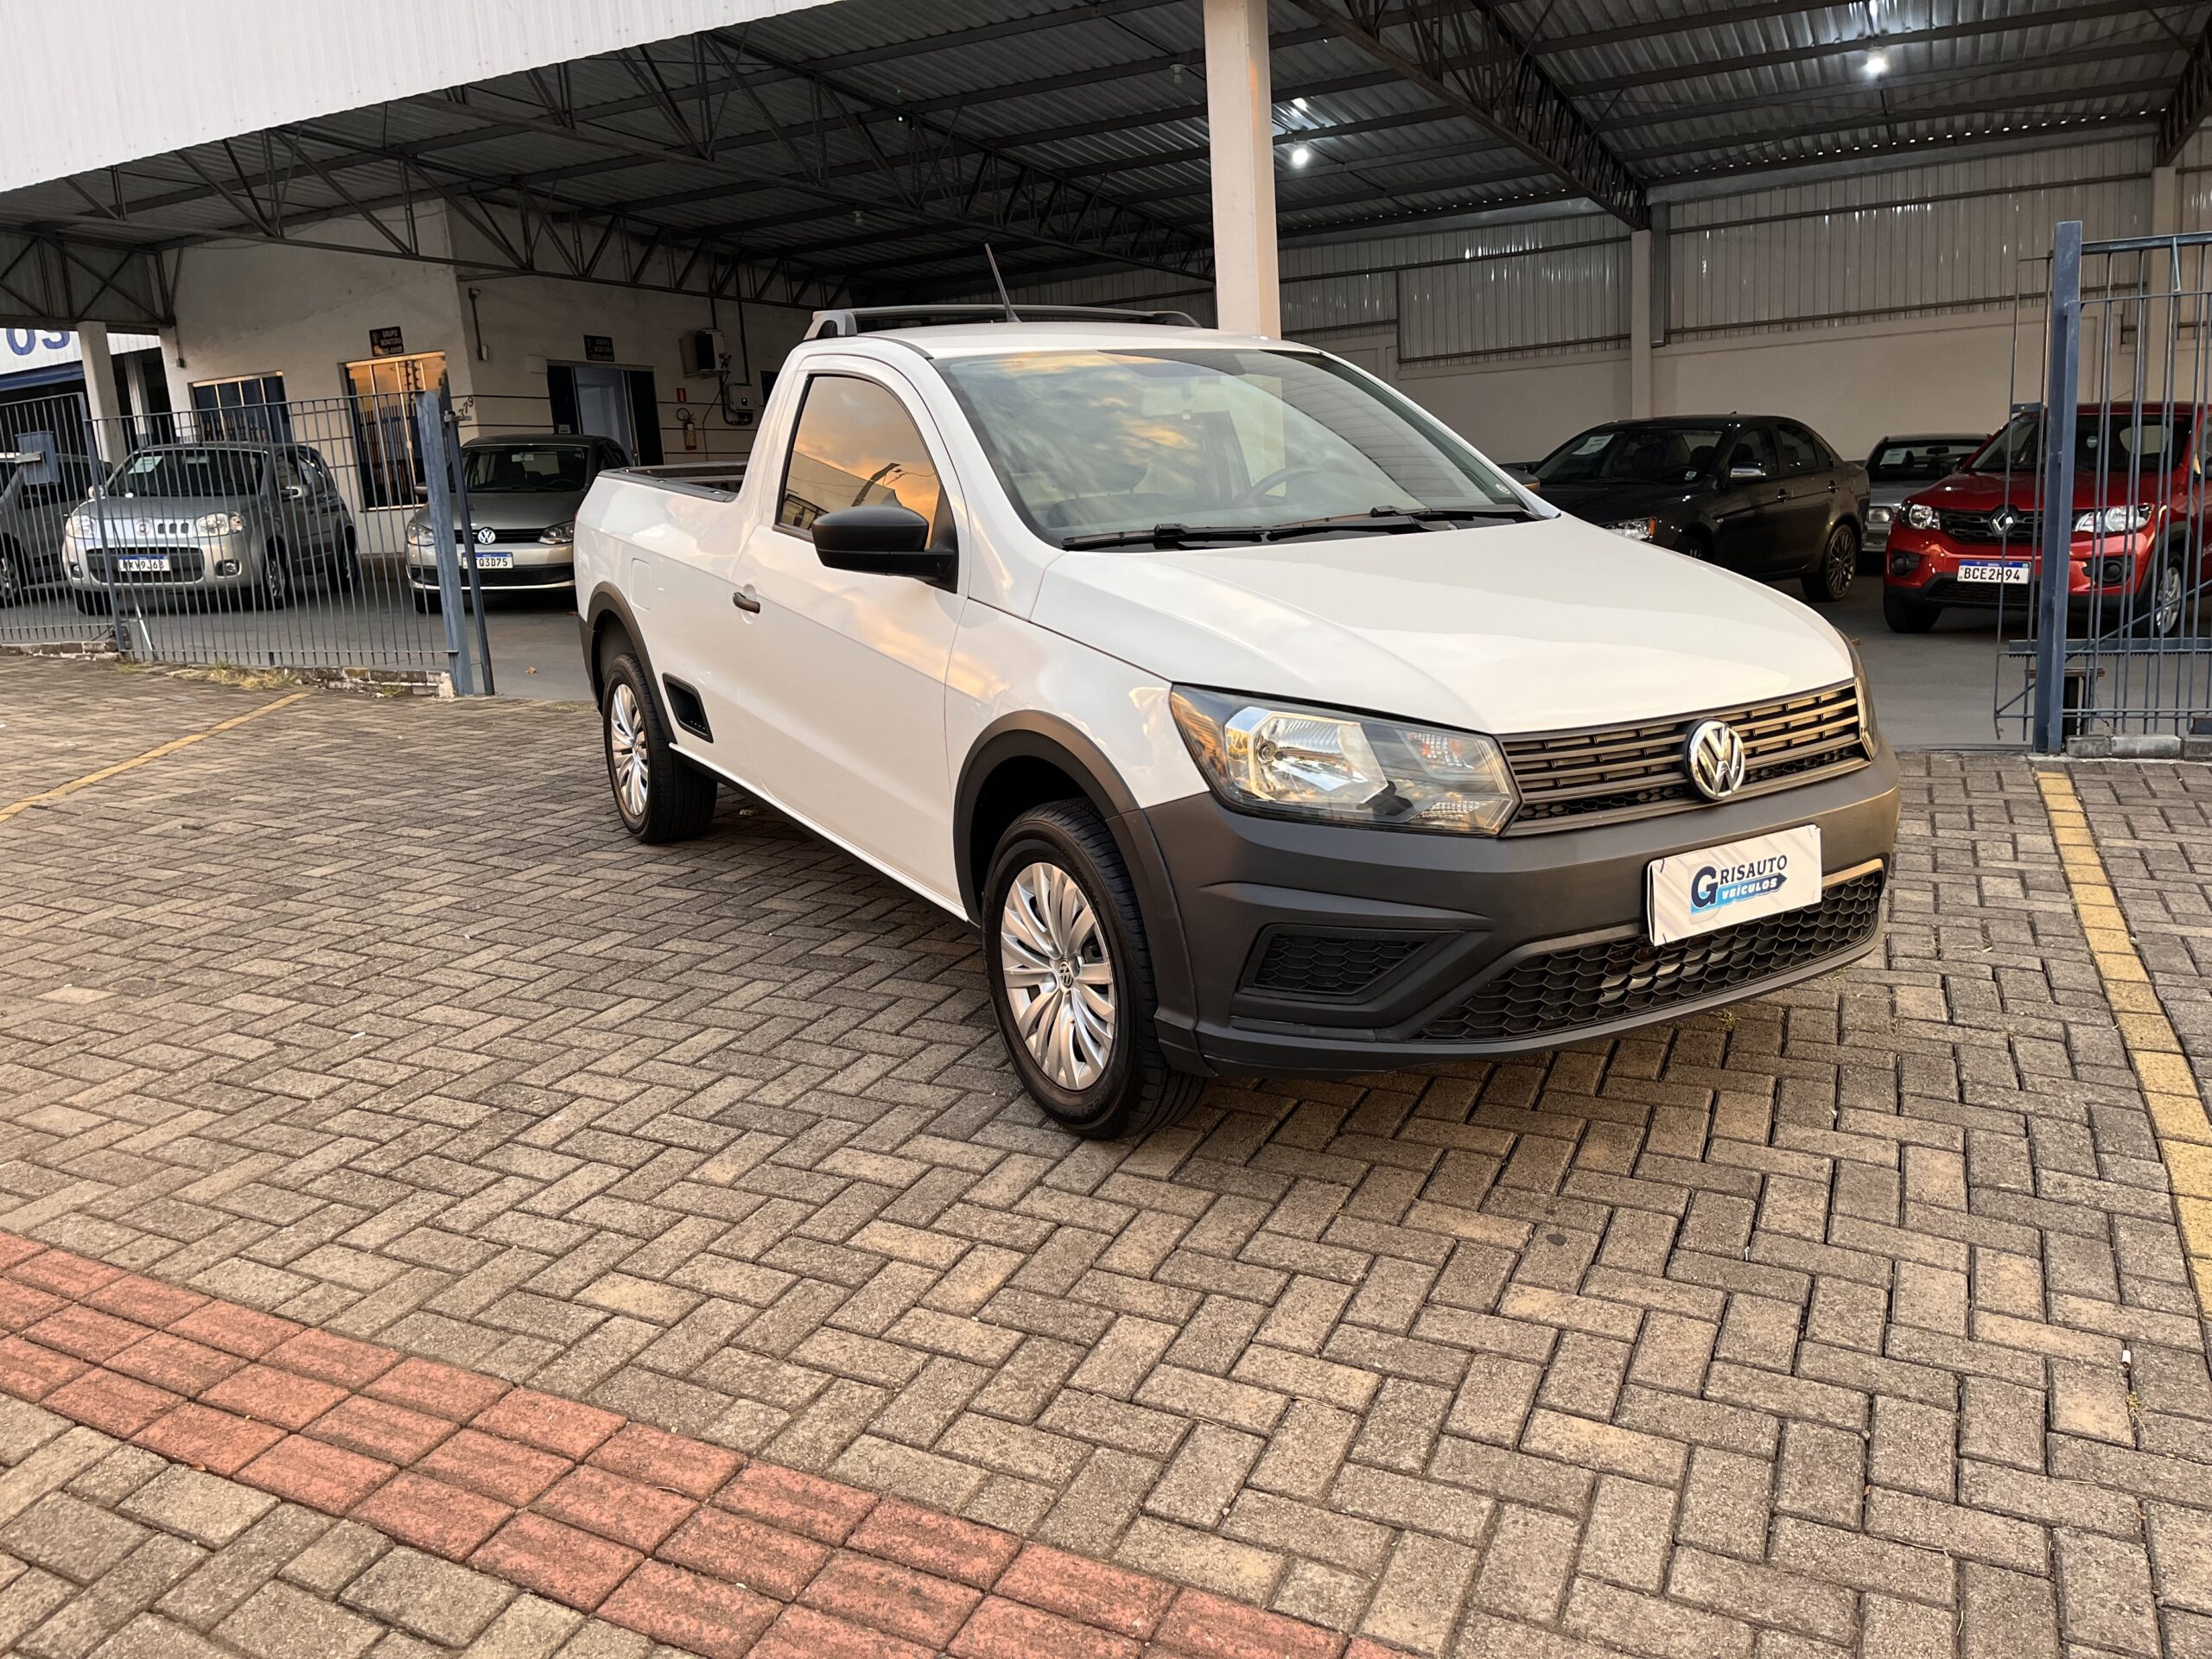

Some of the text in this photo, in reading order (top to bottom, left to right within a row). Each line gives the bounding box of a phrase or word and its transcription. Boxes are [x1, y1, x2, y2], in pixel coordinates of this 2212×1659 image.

[1964, 568, 2019, 581] BCE2H94
[1691, 855, 1788, 908] GRISAUTO
[1721, 877, 1778, 899] VEÍCULOS
